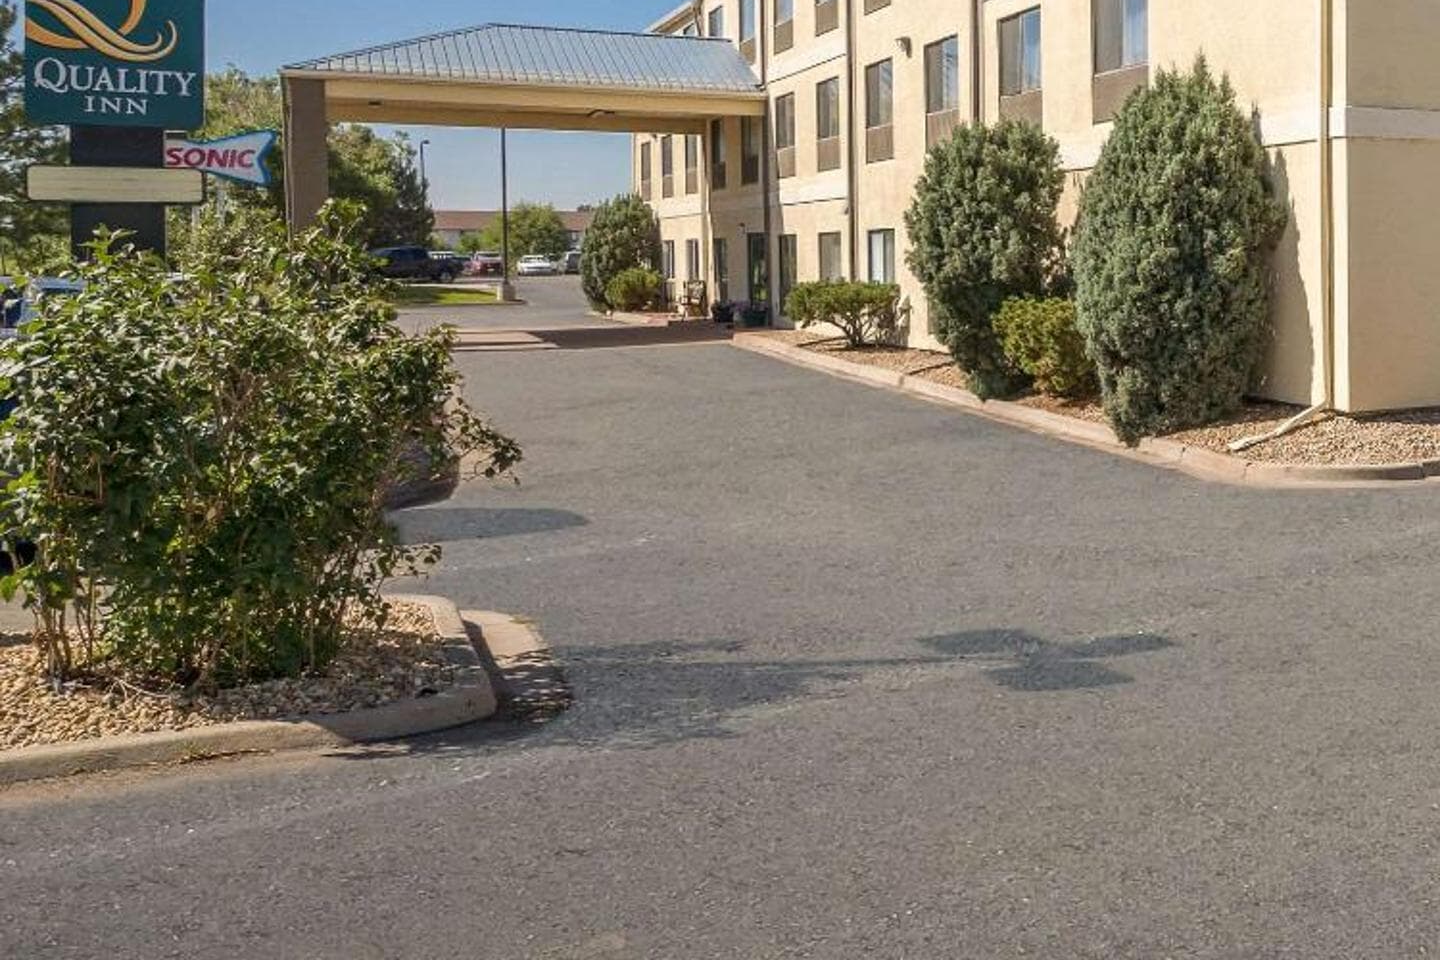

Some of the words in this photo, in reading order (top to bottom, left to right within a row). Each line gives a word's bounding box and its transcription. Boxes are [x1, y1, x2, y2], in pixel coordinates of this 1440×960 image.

[34, 57, 196, 96] QUALITY
[84, 97, 148, 115] INN
[166, 147, 256, 168] SONIC
